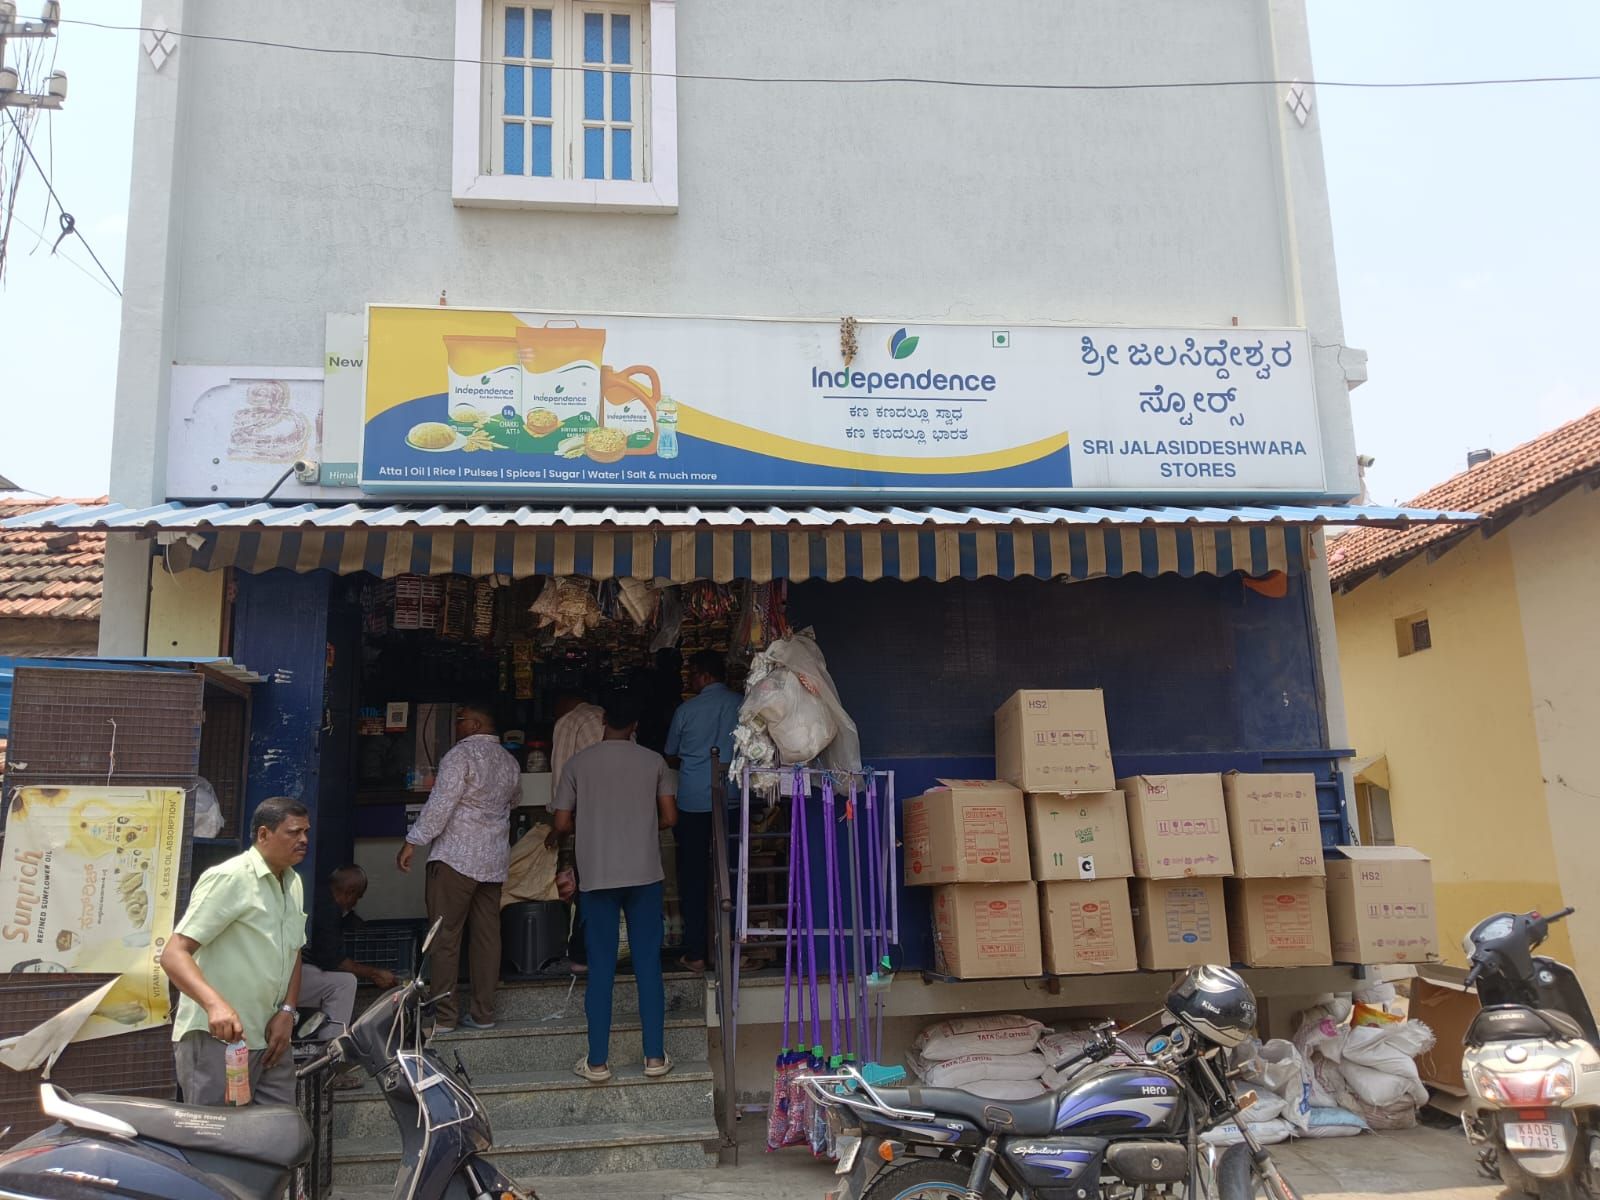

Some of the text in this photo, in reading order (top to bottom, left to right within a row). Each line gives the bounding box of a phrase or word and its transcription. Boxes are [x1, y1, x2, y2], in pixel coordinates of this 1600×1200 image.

[329, 356, 363, 368] New
[1081, 335, 1292, 380] ಶ್ರೀ ಜಲಸಿದ್ದೇಶ್ವರ
[812, 366, 996, 394] Independence
[455, 384, 514, 396] Independence
[533, 393, 587, 403] Independence
[849, 405, 869, 417] ಕಣ
[845, 426, 865, 439] ಕಣ
[932, 427, 968, 442] ಭಾರತ
[1082, 439, 1307, 455] SRI JALASIDDESHWARA
[378, 466, 402, 476] Atta
[410, 466, 425, 476] Oil
[433, 467, 456, 476] Rice
[464, 468, 498, 478] Pulses
[506, 468, 541, 479] Spices
[548, 469, 580, 480] Sugar
[587, 470, 619, 479] Water
[626, 471, 647, 479] Salt
[648, 471, 657, 479] &
[659, 471, 689, 480] much
[1160, 462, 1237, 478] STORES
[1028, 700, 1047, 709] HS2
[164, 853, 172, 866] OIL
[163, 867, 171, 887] LESS
[1361, 871, 1380, 881] HS2
[2, 850, 43, 944] Sunrich
[36, 850, 53, 944] REFINED SUNFLOWER OIL
[152, 966, 161, 998] VITAMIN
[1142, 1086, 1167, 1095] Hero
